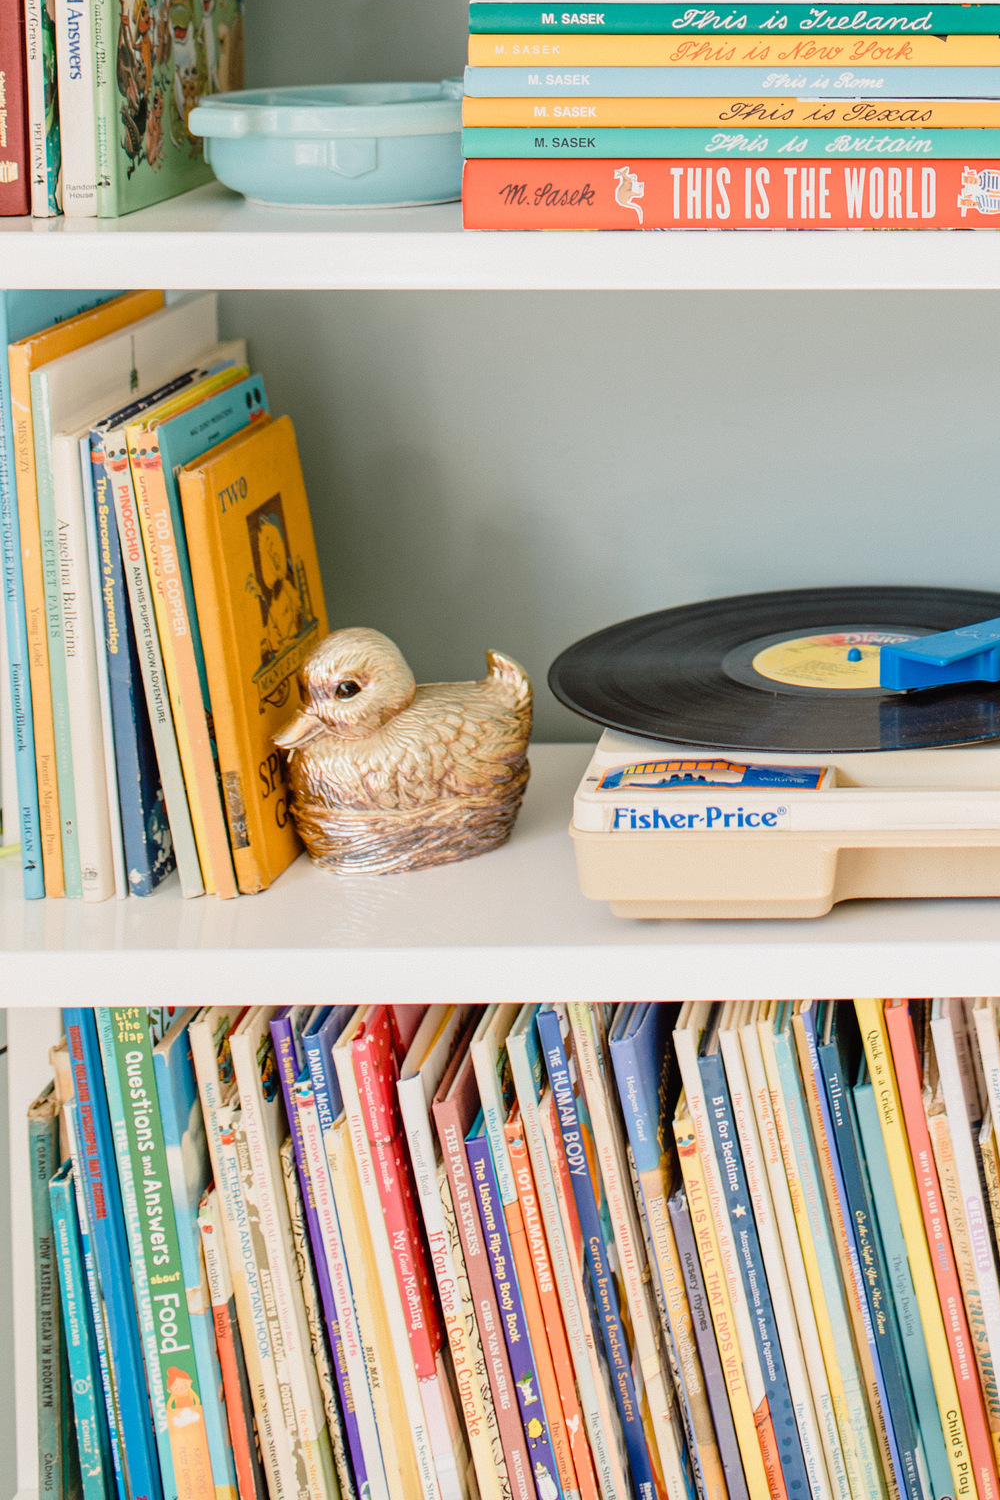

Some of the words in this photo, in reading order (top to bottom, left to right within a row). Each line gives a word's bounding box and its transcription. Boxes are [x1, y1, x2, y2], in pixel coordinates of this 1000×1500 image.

[542, 13, 558, 24] M.
[561, 14, 605, 25] SASEK
[672, 10, 747, 29] This
[760, 11, 788, 29] is
[799, 10, 932, 31] Ireland
[66, 8, 83, 80] Answers
[670, 41, 734, 61] This
[743, 41, 769, 61] is
[778, 42, 843, 61] New
[849, 41, 912, 60] York
[719, 103, 795, 121] This
[803, 104, 836, 121] is
[843, 103, 932, 122] Texas
[33, 123, 43, 170] PELICAN
[534, 138, 549, 148] M.
[552, 138, 596, 148] SASEK
[499, 183, 529, 205] M.
[535, 183, 595, 206] Sasek
[670, 167, 731, 219] THIS
[745, 167, 770, 219] IS
[784, 167, 831, 219] THE
[844, 167, 936, 219] WORLD
[96, 477, 106, 504] The
[218, 476, 248, 513] TWO
[98, 505, 112, 575] Sorcerer's
[118, 485, 140, 562] PINOCCHIO
[153, 510, 169, 539] TOD
[58, 519, 75, 585] Angelina
[158, 545, 174, 574] AND
[63, 591, 78, 657] Ballerina
[102, 576, 119, 654] Apprentice
[166, 578, 186, 637] COPPER
[547, 1046, 561, 1066] THE
[125, 1051, 157, 1151] Questions
[551, 1070, 577, 1127] HUMAN
[713, 1096, 725, 1106] B
[716, 1109, 727, 1117] is
[829, 1073, 845, 1126] Tillman
[444, 1125, 459, 1151] THE
[717, 1120, 732, 1138] for
[141, 1156, 157, 1176] and
[450, 1154, 468, 1197] POLAR
[474, 1158, 486, 1180] The
[564, 1131, 586, 1176] BODY
[720, 1142, 741, 1191] Bedtime
[518, 1166, 532, 1192] 101
[142, 1180, 172, 1266] Answers
[457, 1200, 480, 1256] EXPRESS
[477, 1184, 498, 1231] Usborne
[484, 1233, 509, 1282] Flip-Flap
[522, 1196, 552, 1293] DALMATIANS
[496, 1284, 515, 1311] Body
[153, 1294, 191, 1354] Food
[504, 1312, 520, 1343] Book
